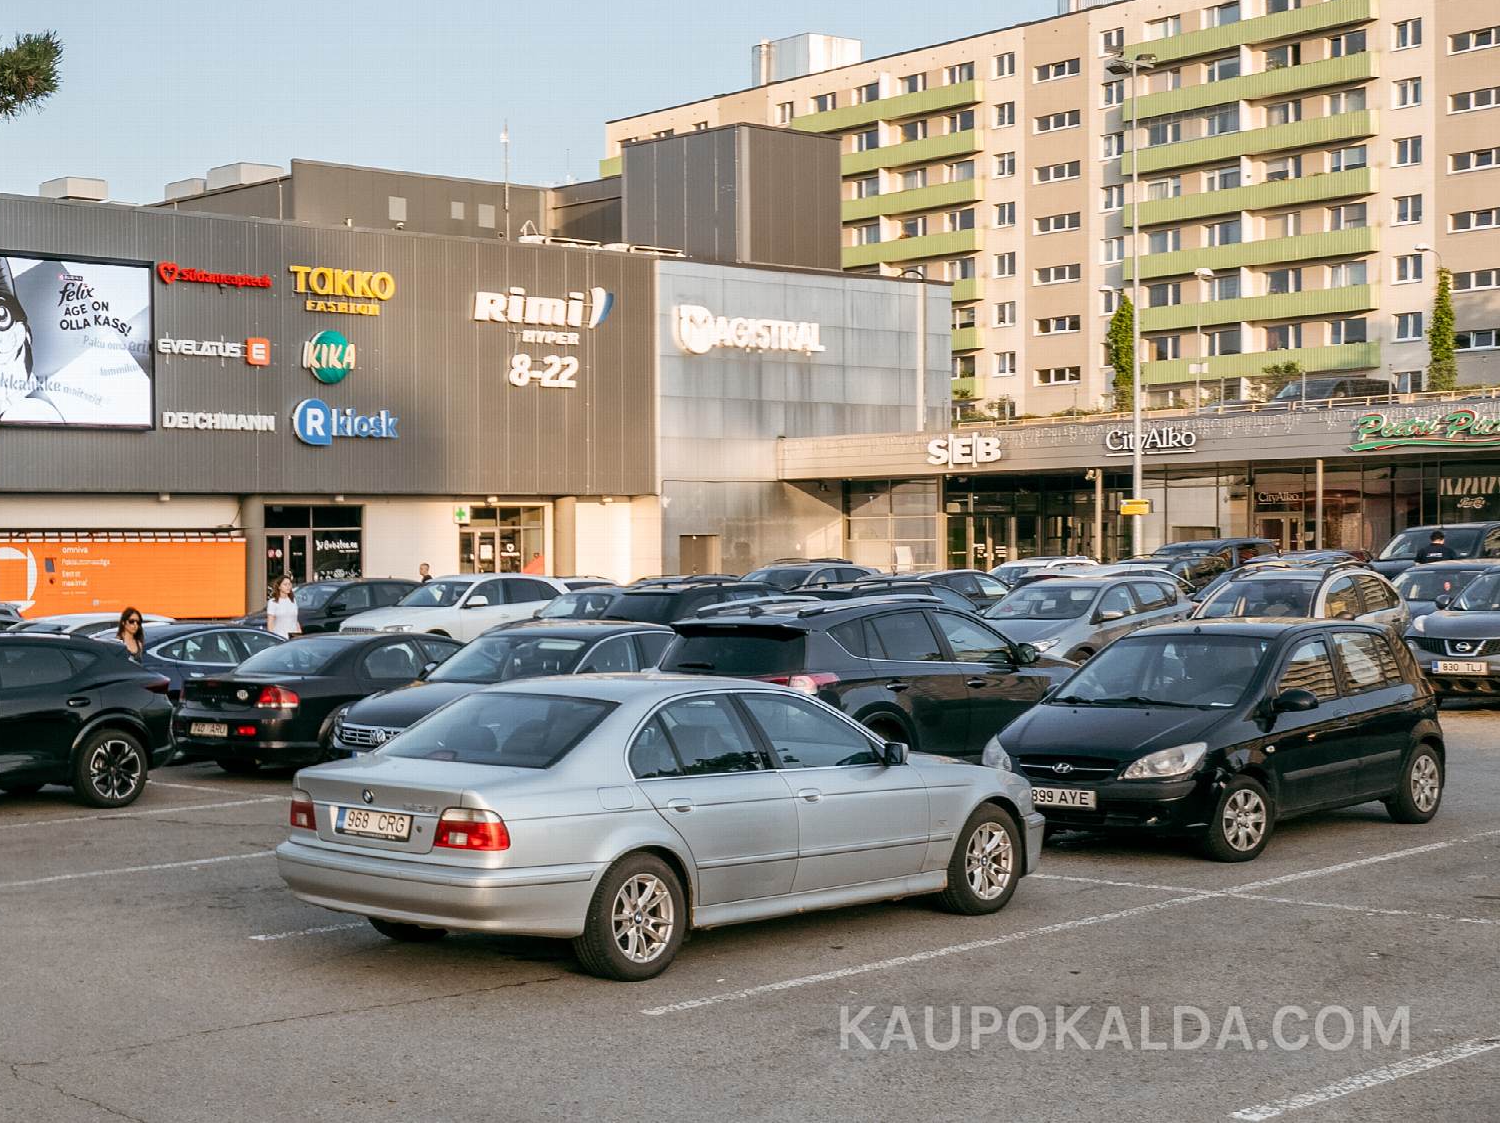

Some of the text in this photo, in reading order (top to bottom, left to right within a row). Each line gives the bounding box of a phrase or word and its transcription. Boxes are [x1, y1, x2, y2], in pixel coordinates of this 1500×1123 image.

[58, 282, 94, 307] felix
[289, 266, 395, 300] TAKKO
[64, 301, 109, 317] ÄGE ON
[474, 287, 585, 327] Rimi
[60, 315, 132, 337] OLLA KASS!
[522, 330, 580, 345] HYPER
[678, 304, 827, 355] MAGISTRAL
[158, 339, 241, 358] EVELATUS
[303, 341, 356, 370] KIKA
[509, 354, 579, 388] 8-22
[163, 412, 275, 432] DEICHMANN
[306, 408, 399, 438] R kiosk
[928, 433, 1002, 469] SEB
[1443, 663, 1482, 673] 830 TLJ
[1058, 791, 1090, 806] AYE
[348, 811, 405, 833] 968 CRG
